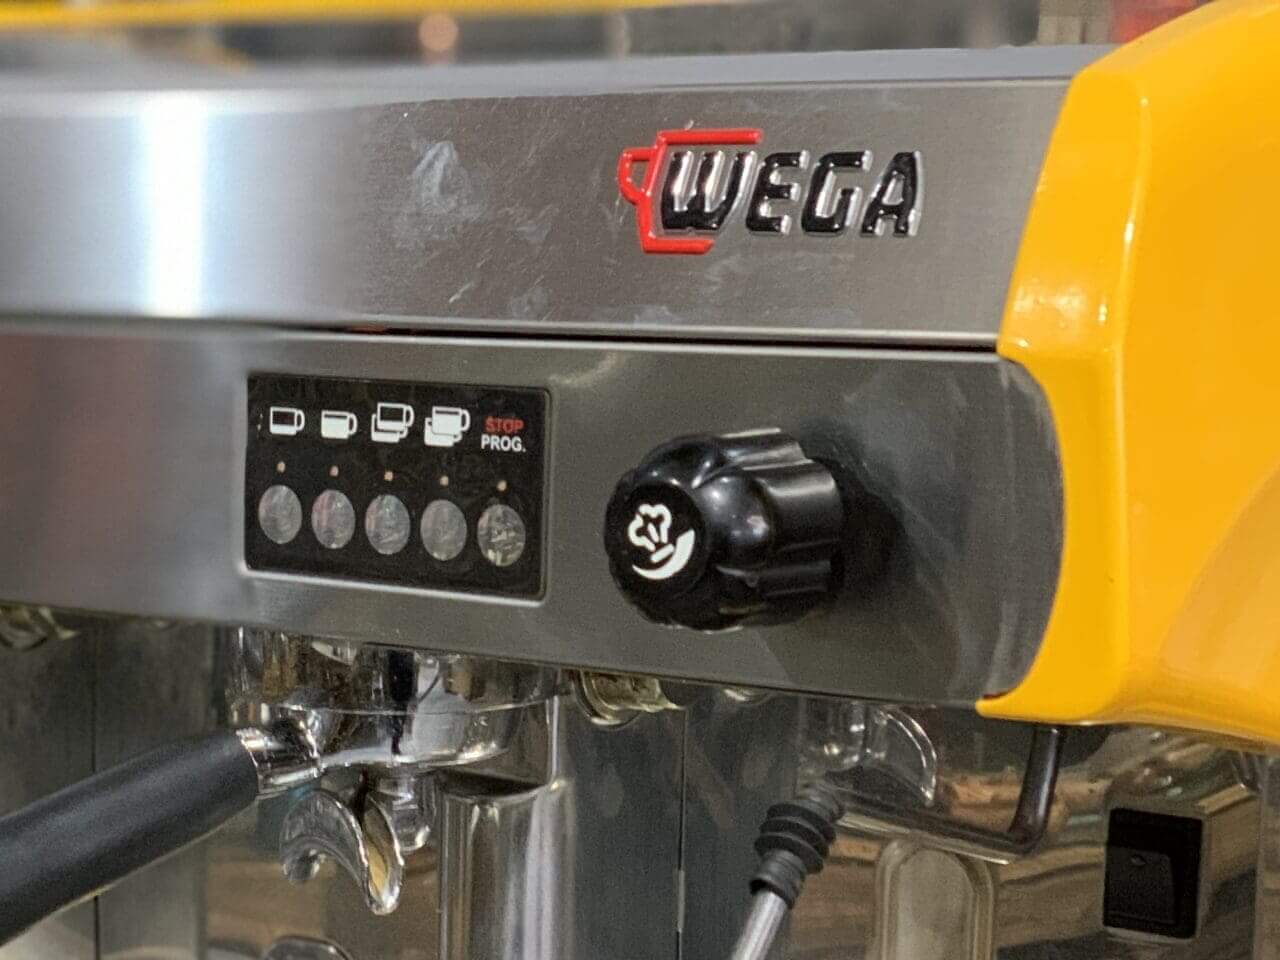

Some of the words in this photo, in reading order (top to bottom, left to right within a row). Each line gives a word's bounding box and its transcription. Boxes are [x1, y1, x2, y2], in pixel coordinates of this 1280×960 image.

[661, 150, 920, 236] WEGA
[485, 415, 524, 432] STOP
[480, 433, 526, 452] PROG.
